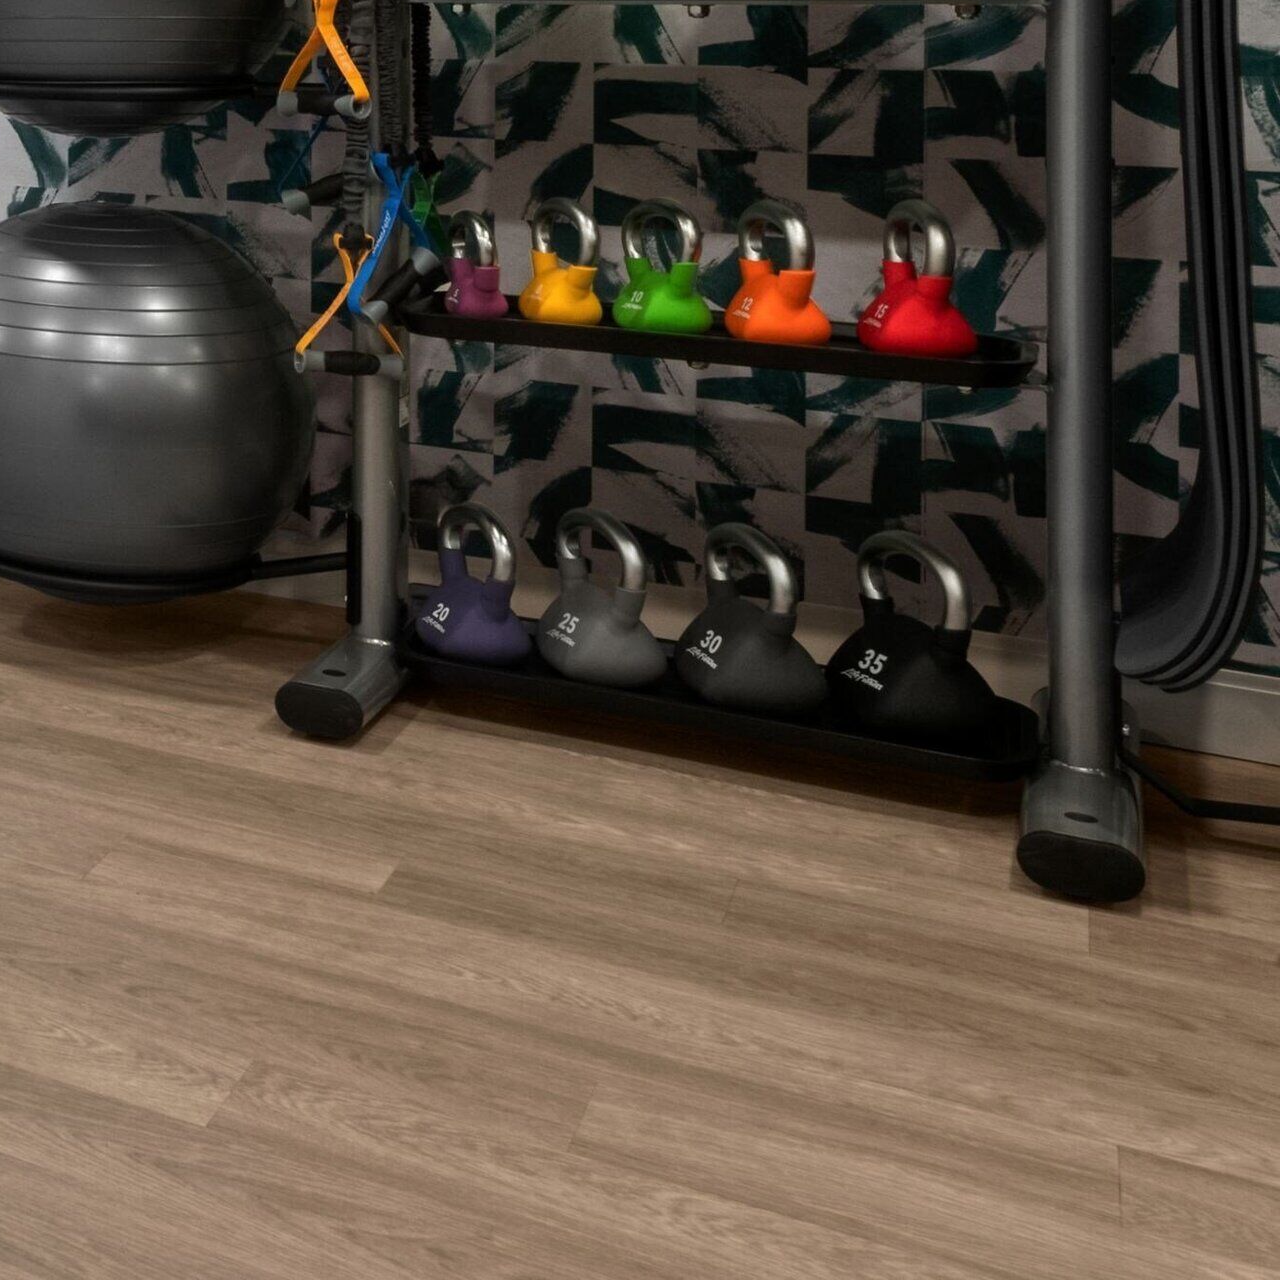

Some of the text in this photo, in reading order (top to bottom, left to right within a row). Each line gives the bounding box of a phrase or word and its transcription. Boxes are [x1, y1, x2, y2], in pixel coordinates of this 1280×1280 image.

[630, 290, 644, 303] 10
[741, 296, 754, 311] 12
[874, 303, 889, 319] 15
[432, 602, 450, 622] 20
[557, 612, 580, 634] 25
[700, 629, 723, 654] 30
[857, 648, 888, 675] 35
